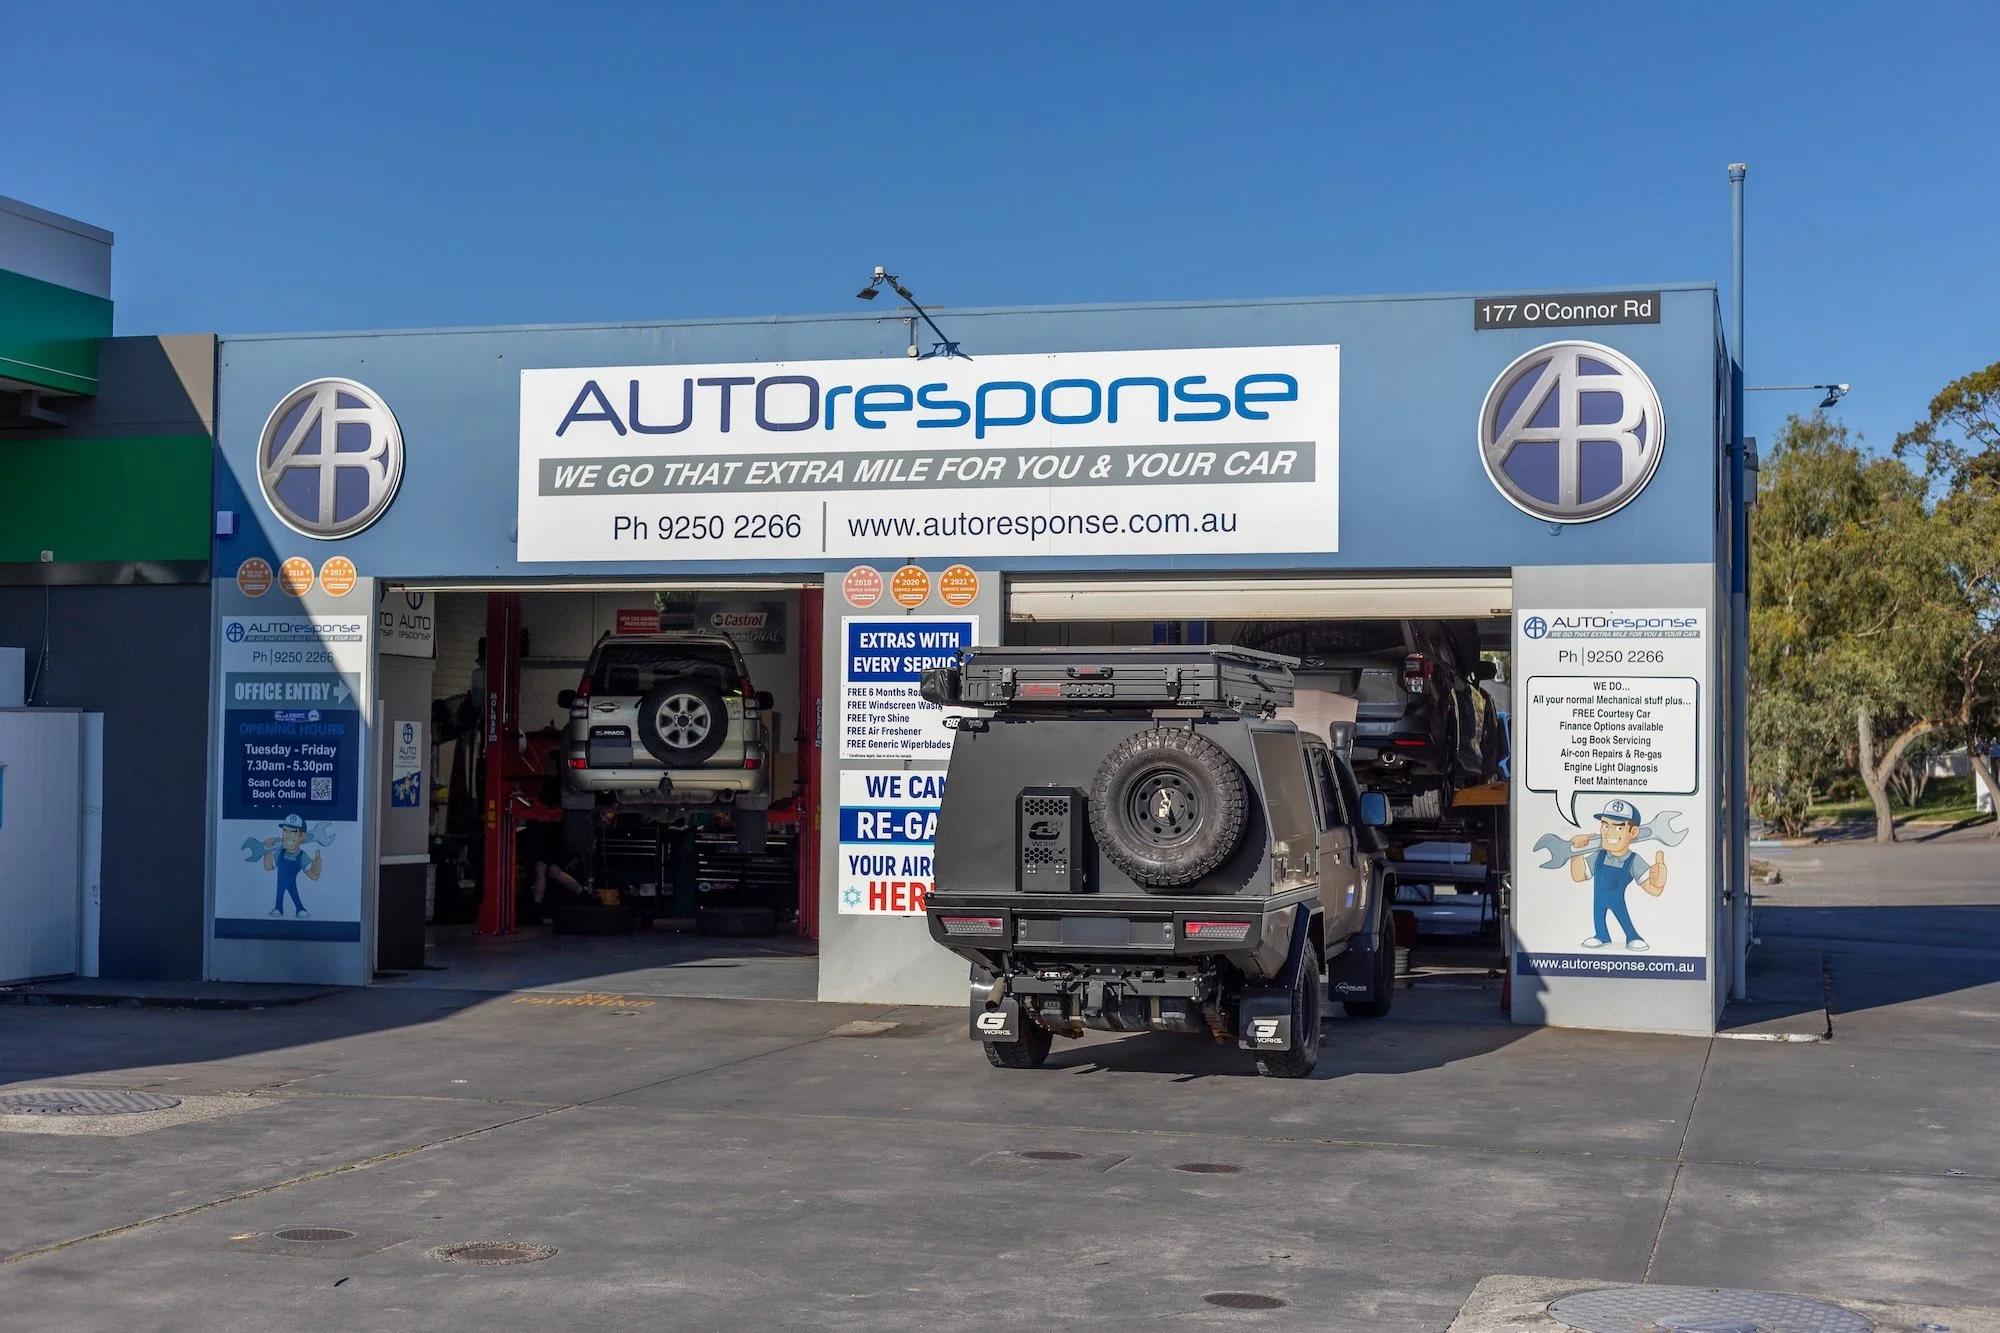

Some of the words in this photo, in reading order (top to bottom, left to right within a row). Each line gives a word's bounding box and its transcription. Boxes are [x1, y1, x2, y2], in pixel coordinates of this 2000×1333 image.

[1482, 304, 1517, 322] 177
[1523, 302, 1617, 321] O'Connor
[1624, 299, 1652, 317] Rd
[555, 373, 1298, 440] AUTOresponse
[554, 465, 602, 488] WE
[607, 463, 654, 488] GO
[664, 461, 744, 487] THAT
[745, 459, 844, 485] EXTRA
[853, 457, 934, 483] MILE
[936, 456, 1007, 483] FOR
[1015, 454, 1085, 480] YOU
[1088, 455, 1112, 478] &
[1124, 452, 1217, 478] YOUR
[1224, 450, 1299, 476] CAR
[613, 516, 647, 541] Ph
[657, 514, 724, 540] 9250
[734, 514, 802, 539] 2266
[848, 511, 1238, 542] www.autoresponse.com.au
[330, 568, 346, 576] 2017
[399, 614, 431, 631] AUTO
[724, 613, 764, 627] Castrol
[1552, 616, 1697, 630] AUTOresponse
[248, 622, 360, 634] AUTOresponse
[860, 632, 915, 648] EXTRAS
[919, 632, 960, 648] WITH
[252, 651, 267, 663] Ph
[274, 652, 302, 663] 9250
[306, 652, 334, 663] 2266
[1558, 650, 1577, 662] Ph
[1587, 651, 1623, 663] 9250
[1628, 651, 1664, 663] 2266
[853, 656, 900, 673] EVERY
[234, 682, 283, 700] OFFICE
[286, 682, 330, 700] ENTRY
[847, 688, 866, 696] FREE
[868, 688, 874, 696] 6
[876, 688, 906, 697] Months
[1593, 682, 1607, 690] WE
[1609, 682, 1630, 691] DO...
[847, 701, 866, 709] FREE
[868, 701, 916, 710] Windscreen
[1533, 696, 1544, 704] All
[1546, 697, 1564, 706] your
[1566, 695, 1594, 704] normal
[1596, 696, 1642, 704] Mechanical
[1644, 696, 1663, 705] stuff
[1665, 696, 1692, 707] plus...
[847, 714, 866, 722] FREE
[868, 714, 886, 724] Tyre
[888, 714, 910, 722] Shine
[1572, 709, 1595, 718] FREE
[1597, 709, 1634, 720] Courtesy
[1636, 710, 1651, 718] Car
[239, 723, 296, 735] OPENING
[300, 723, 345, 736] HOURS
[847, 727, 866, 735] FREE
[868, 727, 879, 736] Air
[882, 727, 922, 736] Freshener
[1560, 722, 1591, 731] Finance
[1594, 722, 1626, 732] Options
[1628, 722, 1664, 731] available
[847, 740, 866, 748] FREE
[868, 740, 898, 748] Generic
[900, 740, 951, 750] Wiperblades
[1572, 736, 1587, 746] Log
[1589, 736, 1610, 744] Book
[1613, 736, 1651, 747] Servicing
[245, 744, 291, 757] Tuesday
[301, 744, 336, 757] Friday
[1561, 749, 1590, 758] Air-con
[1592, 749, 1623, 760] Repairs
[1625, 750, 1631, 758] &
[1634, 750, 1662, 760] Re-gas
[247, 760, 285, 771] 7.30am
[293, 760, 333, 773] 5.30pm
[1564, 763, 1592, 774] Engine
[1594, 763, 1615, 774] Light
[1617, 763, 1658, 774] Diagnosis
[248, 778, 270, 787] Scan
[272, 778, 295, 787] Code
[298, 779, 306, 787] to
[866, 776, 901, 798] WE
[1574, 777, 1594, 785] Fleet
[1596, 777, 1648, 786] Maintenance
[252, 790, 276, 799] Book
[278, 790, 306, 799] Online
[849, 855, 896, 876] YOUR
[901, 856, 934, 876] AIR
[869, 881, 936, 912] HER
[1528, 958, 1694, 973] www.autoresponse.com.au
